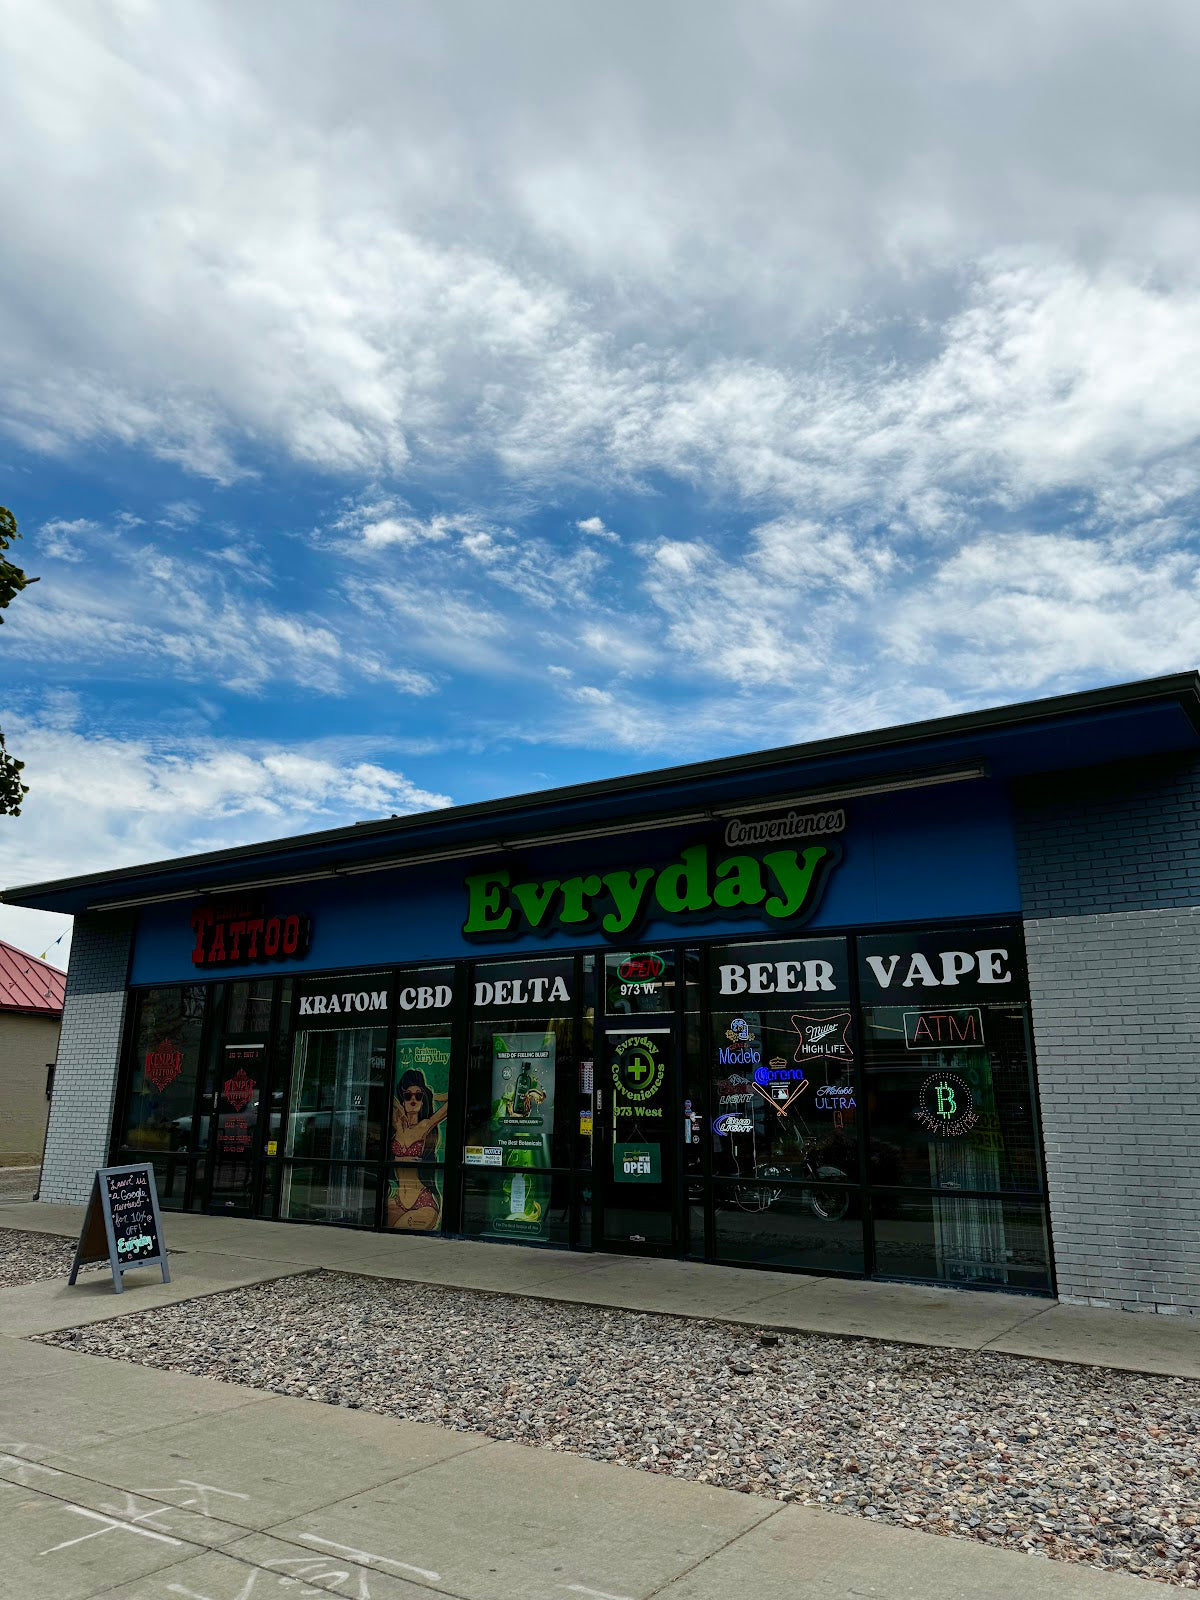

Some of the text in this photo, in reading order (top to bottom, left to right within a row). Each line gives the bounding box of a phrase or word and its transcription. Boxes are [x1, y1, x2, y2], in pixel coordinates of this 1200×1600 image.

[726, 809, 845, 846] Conveniences
[463, 844, 828, 933] Evryday
[191, 907, 299, 963] TATTOO
[620, 960, 661, 979] OPEN
[719, 960, 836, 995] BEER
[866, 949, 1012, 988] VAPE
[400, 985, 453, 1011] CBD
[474, 977, 571, 1006] DELTA
[620, 983, 658, 996] 973 W.
[299, 991, 388, 1015] KRATOM
[805, 1024, 839, 1042] Miller
[914, 1015, 976, 1042] ATM
[615, 1037, 659, 1055] Evryday
[801, 1044, 846, 1054] HIGH LIFE
[718, 1048, 761, 1065] Modelo
[611, 1064, 665, 1100] Conveniences
[754, 1066, 804, 1087] Corona
[719, 1093, 754, 1105] LIGHT
[815, 1097, 857, 1109] ULTRA
[613, 1106, 663, 1117] 973 West
[623, 1162, 651, 1174] OPEN
[120, 1188, 148, 1201] Google
